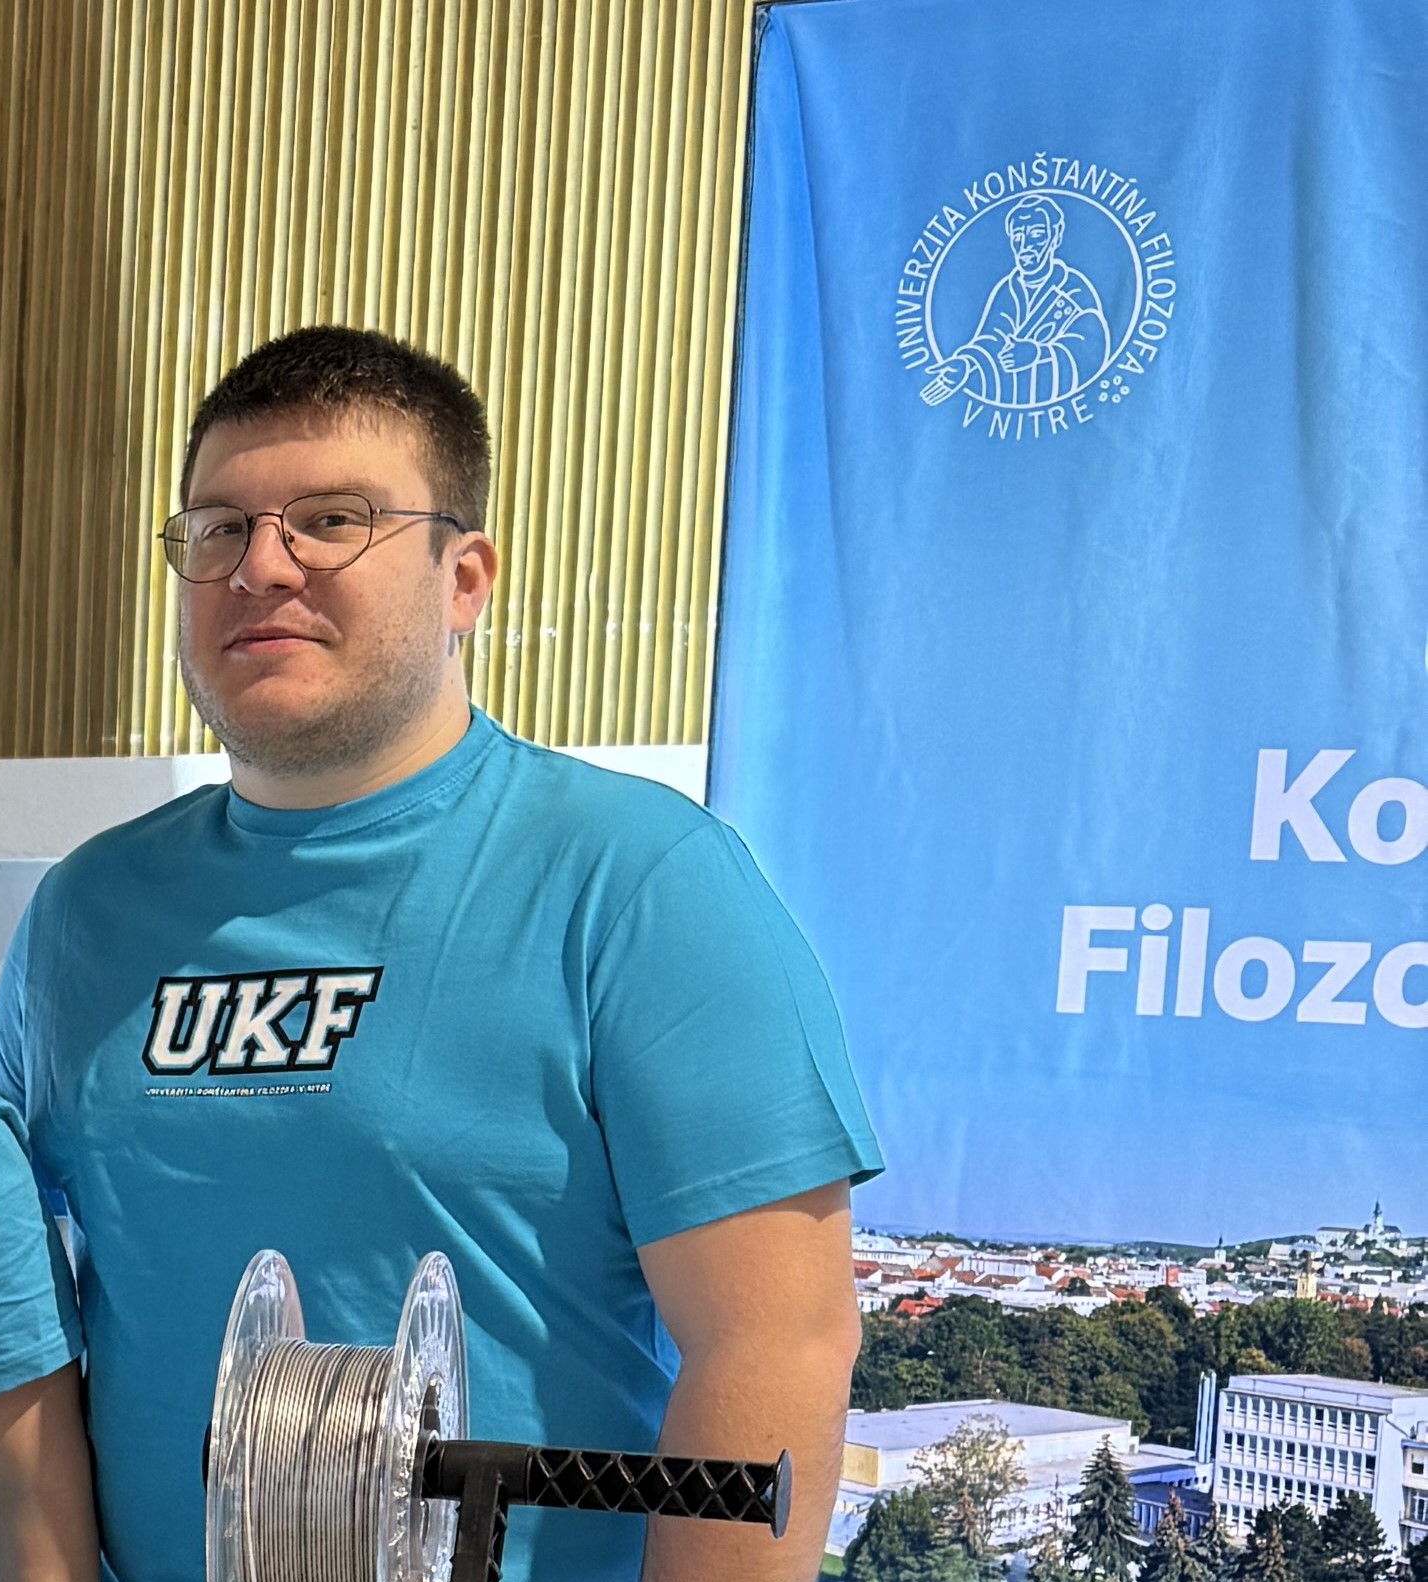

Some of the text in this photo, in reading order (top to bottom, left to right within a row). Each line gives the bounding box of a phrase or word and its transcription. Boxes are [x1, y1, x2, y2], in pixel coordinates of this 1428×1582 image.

[895, 151, 1176, 374] UNIVERZITA KONŠTANTÍNA FILOZOFA
[962, 394, 1093, 440] V NITRE
[141, 966, 384, 1076] UKF
